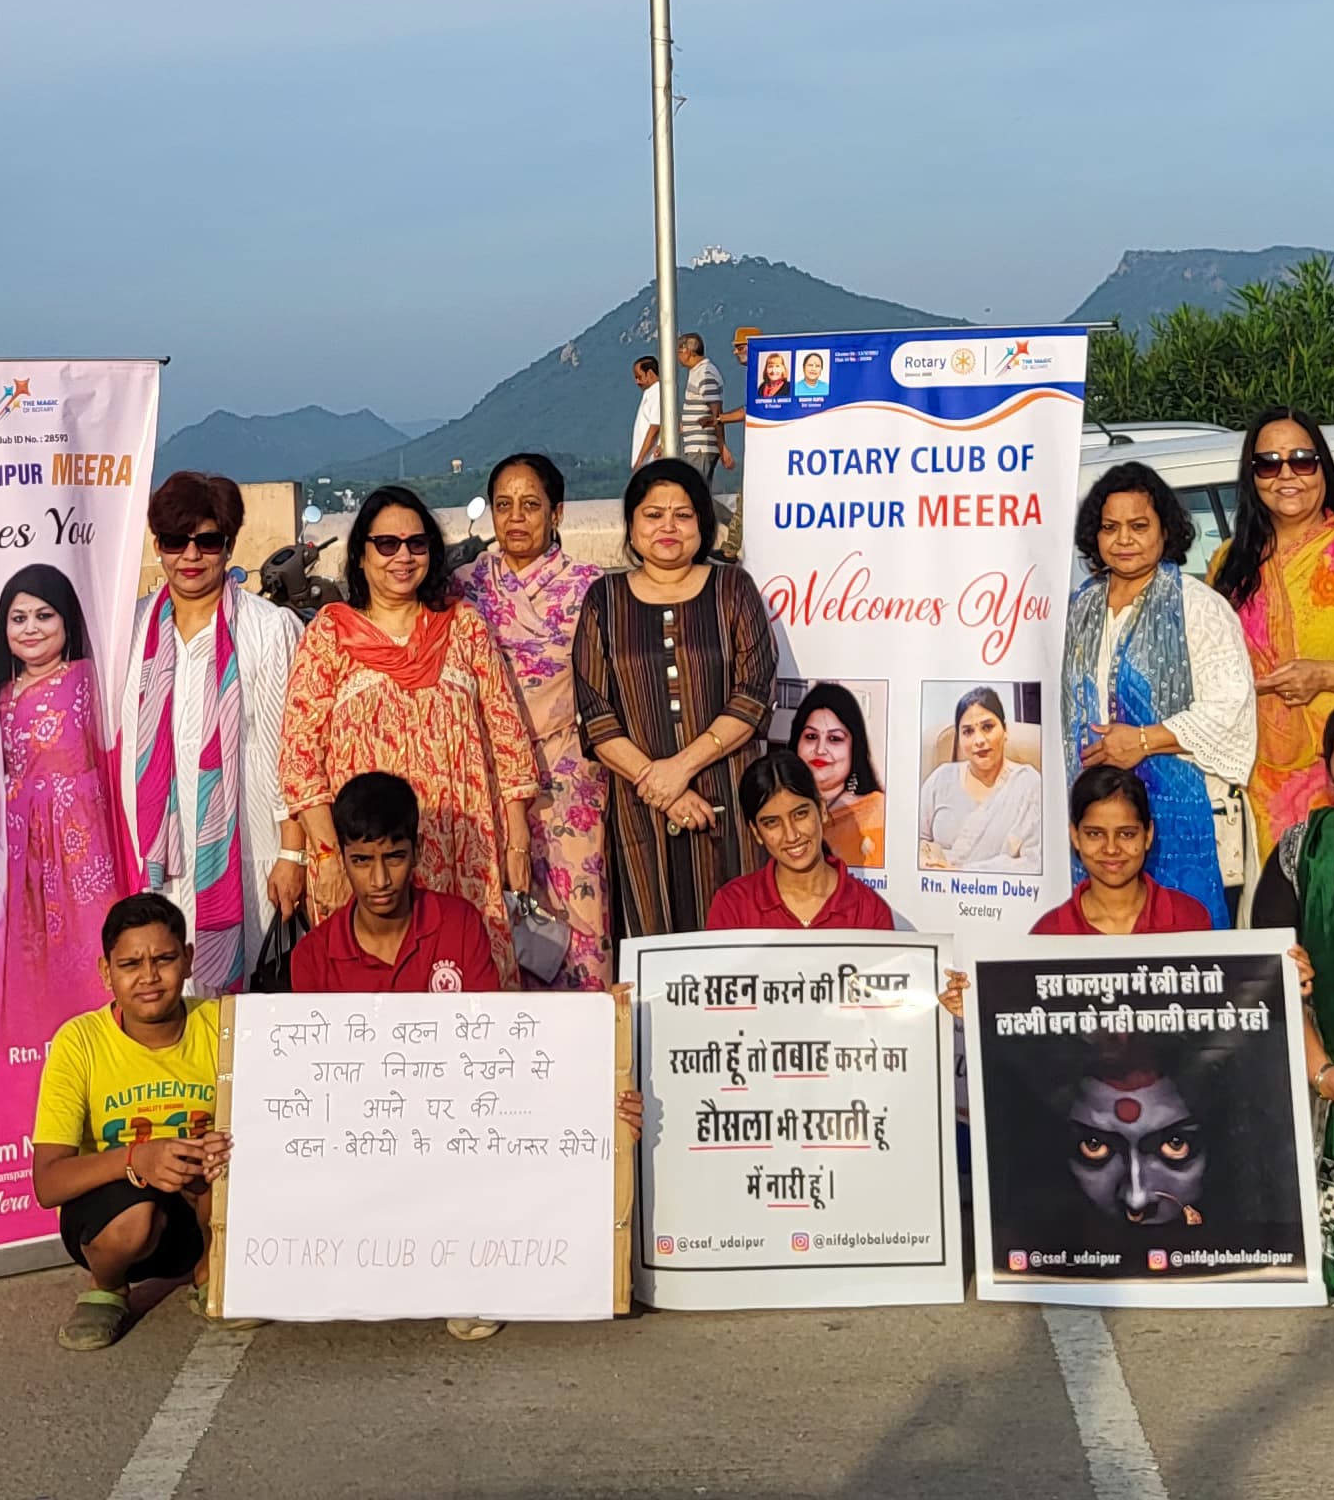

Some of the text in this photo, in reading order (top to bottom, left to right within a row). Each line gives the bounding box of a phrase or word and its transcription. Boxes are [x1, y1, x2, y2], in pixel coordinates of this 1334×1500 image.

[905, 356, 947, 369] Rotary
[14, 435, 23, 444] ID
[52, 453, 132, 486] MEERA
[787, 444, 1034, 476] ROTARY CLUB OF
[45, 506, 96, 546] You
[774, 492, 1042, 529] UDAIPUR MEERA
[761, 551, 1051, 666] Welcomes You
[920, 876, 946, 893] Rtn.
[951, 877, 998, 896] Neelam
[1002, 880, 1039, 901] Dubey
[958, 901, 1002, 920] Secretary
[666, 974, 701, 1006] यदि
[703, 974, 759, 1005] सहन
[762, 972, 805, 1004] करने
[810, 972, 835, 1004] की
[1035, 963, 1225, 1004] इस कलयुग में स्त्री हो तो
[344, 1013, 376, 1043] कि
[455, 1012, 496, 1040] बेटी
[508, 1012, 541, 1041] को
[995, 1006, 1047, 1035] लक्ष्मी
[1048, 1012, 1077, 1034] बन
[1078, 1004, 1098, 1033] के
[1135, 1003, 1185, 1032] काली
[1186, 1009, 1215, 1032] बन
[1216, 1002, 1238, 1031] के
[1238, 1001, 1270, 1031] रहो
[8, 1046, 41, 1066] Rtn.
[460, 1048, 515, 1080] देखने
[530, 1050, 555, 1080] से
[669, 1030, 908, 1086] रखती हूं तो तबाह करने का
[104, 1081, 215, 1113] AUTHENTIC
[264, 1089, 313, 1121] पहले
[363, 1090, 407, 1119] अपने
[426, 1099, 455, 1120] घर
[696, 1098, 890, 1151] हौसला भी रखती हूं
[285, 1138, 325, 1158] बहन
[413, 1129, 431, 1156] के
[446, 1128, 480, 1157] बारे
[766, 1167, 806, 1199] नारी
[244, 1237, 569, 1268] ROTARY CLUB OF UDAIPUR
[676, 1232, 931, 1252] @csaf_udaipur @nifdglobaludaipur
